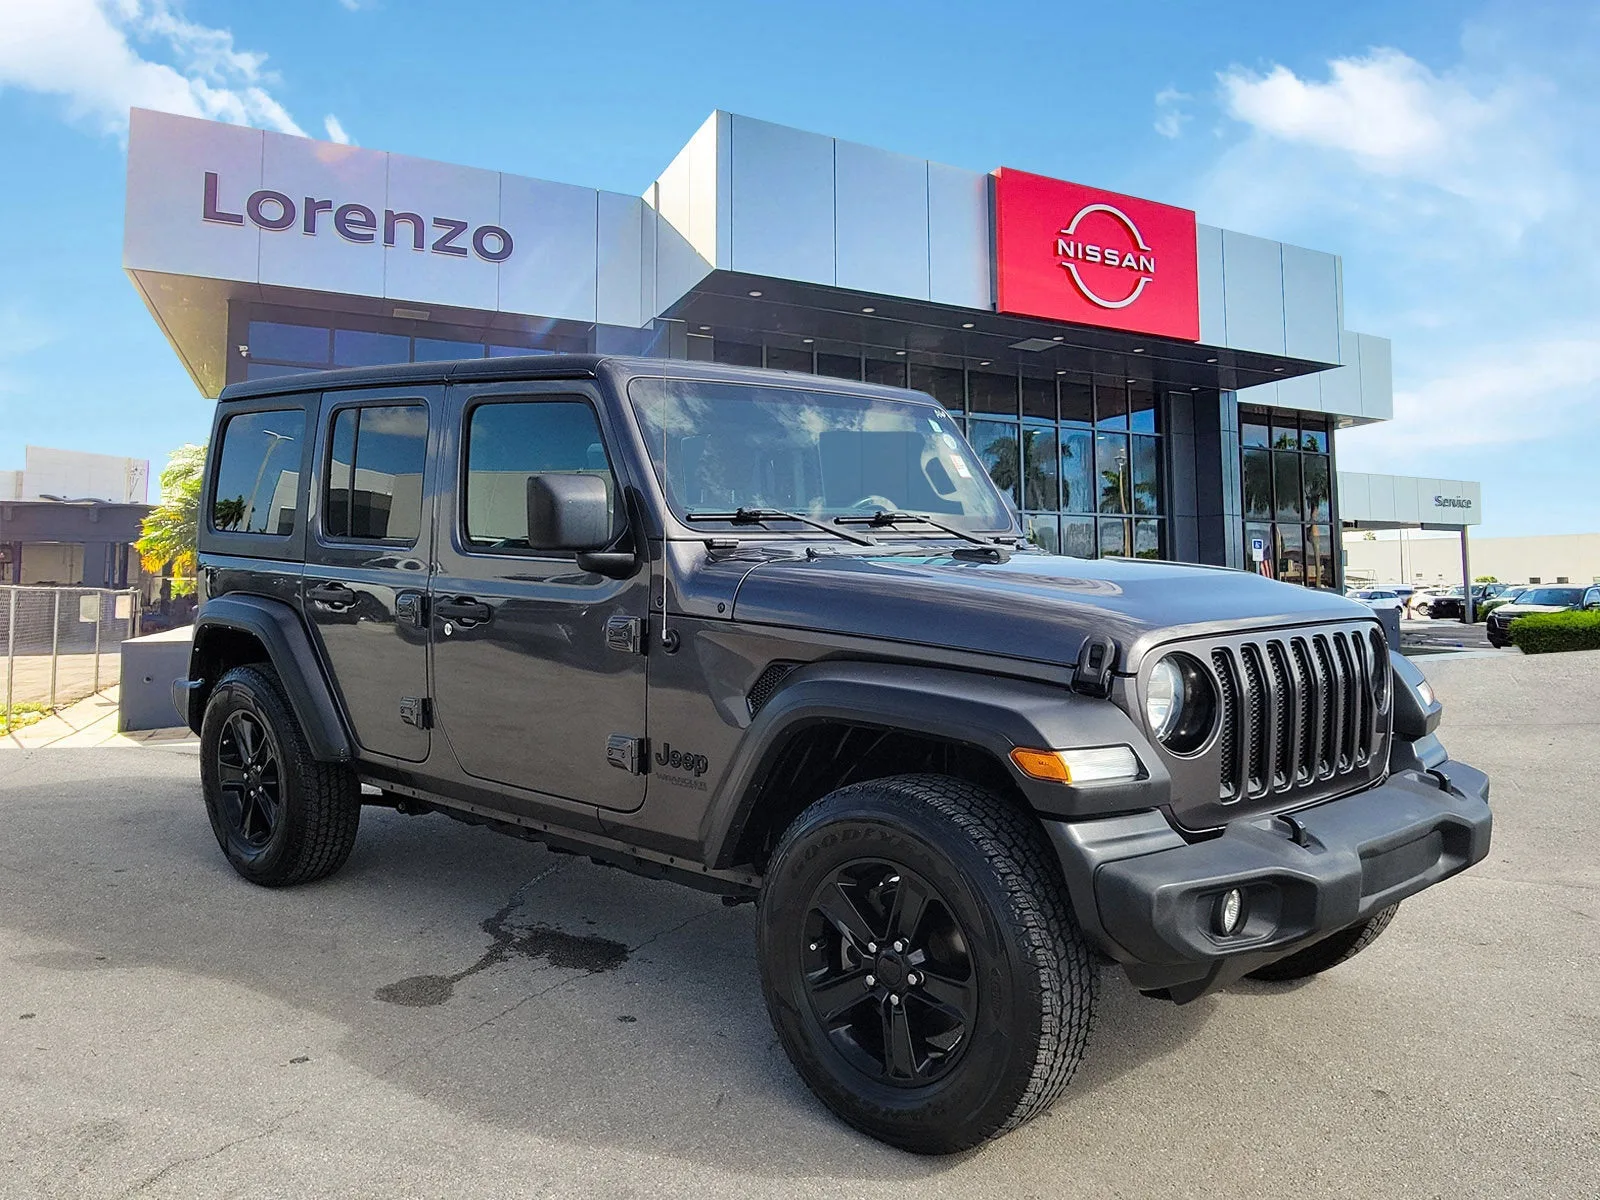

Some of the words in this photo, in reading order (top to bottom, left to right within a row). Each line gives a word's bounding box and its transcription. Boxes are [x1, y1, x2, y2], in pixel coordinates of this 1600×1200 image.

[202, 171, 515, 262] Lorenzo
[1057, 238, 1155, 273] NISSAN
[1434, 495, 1472, 509] Service
[655, 742, 709, 778] Jeep
